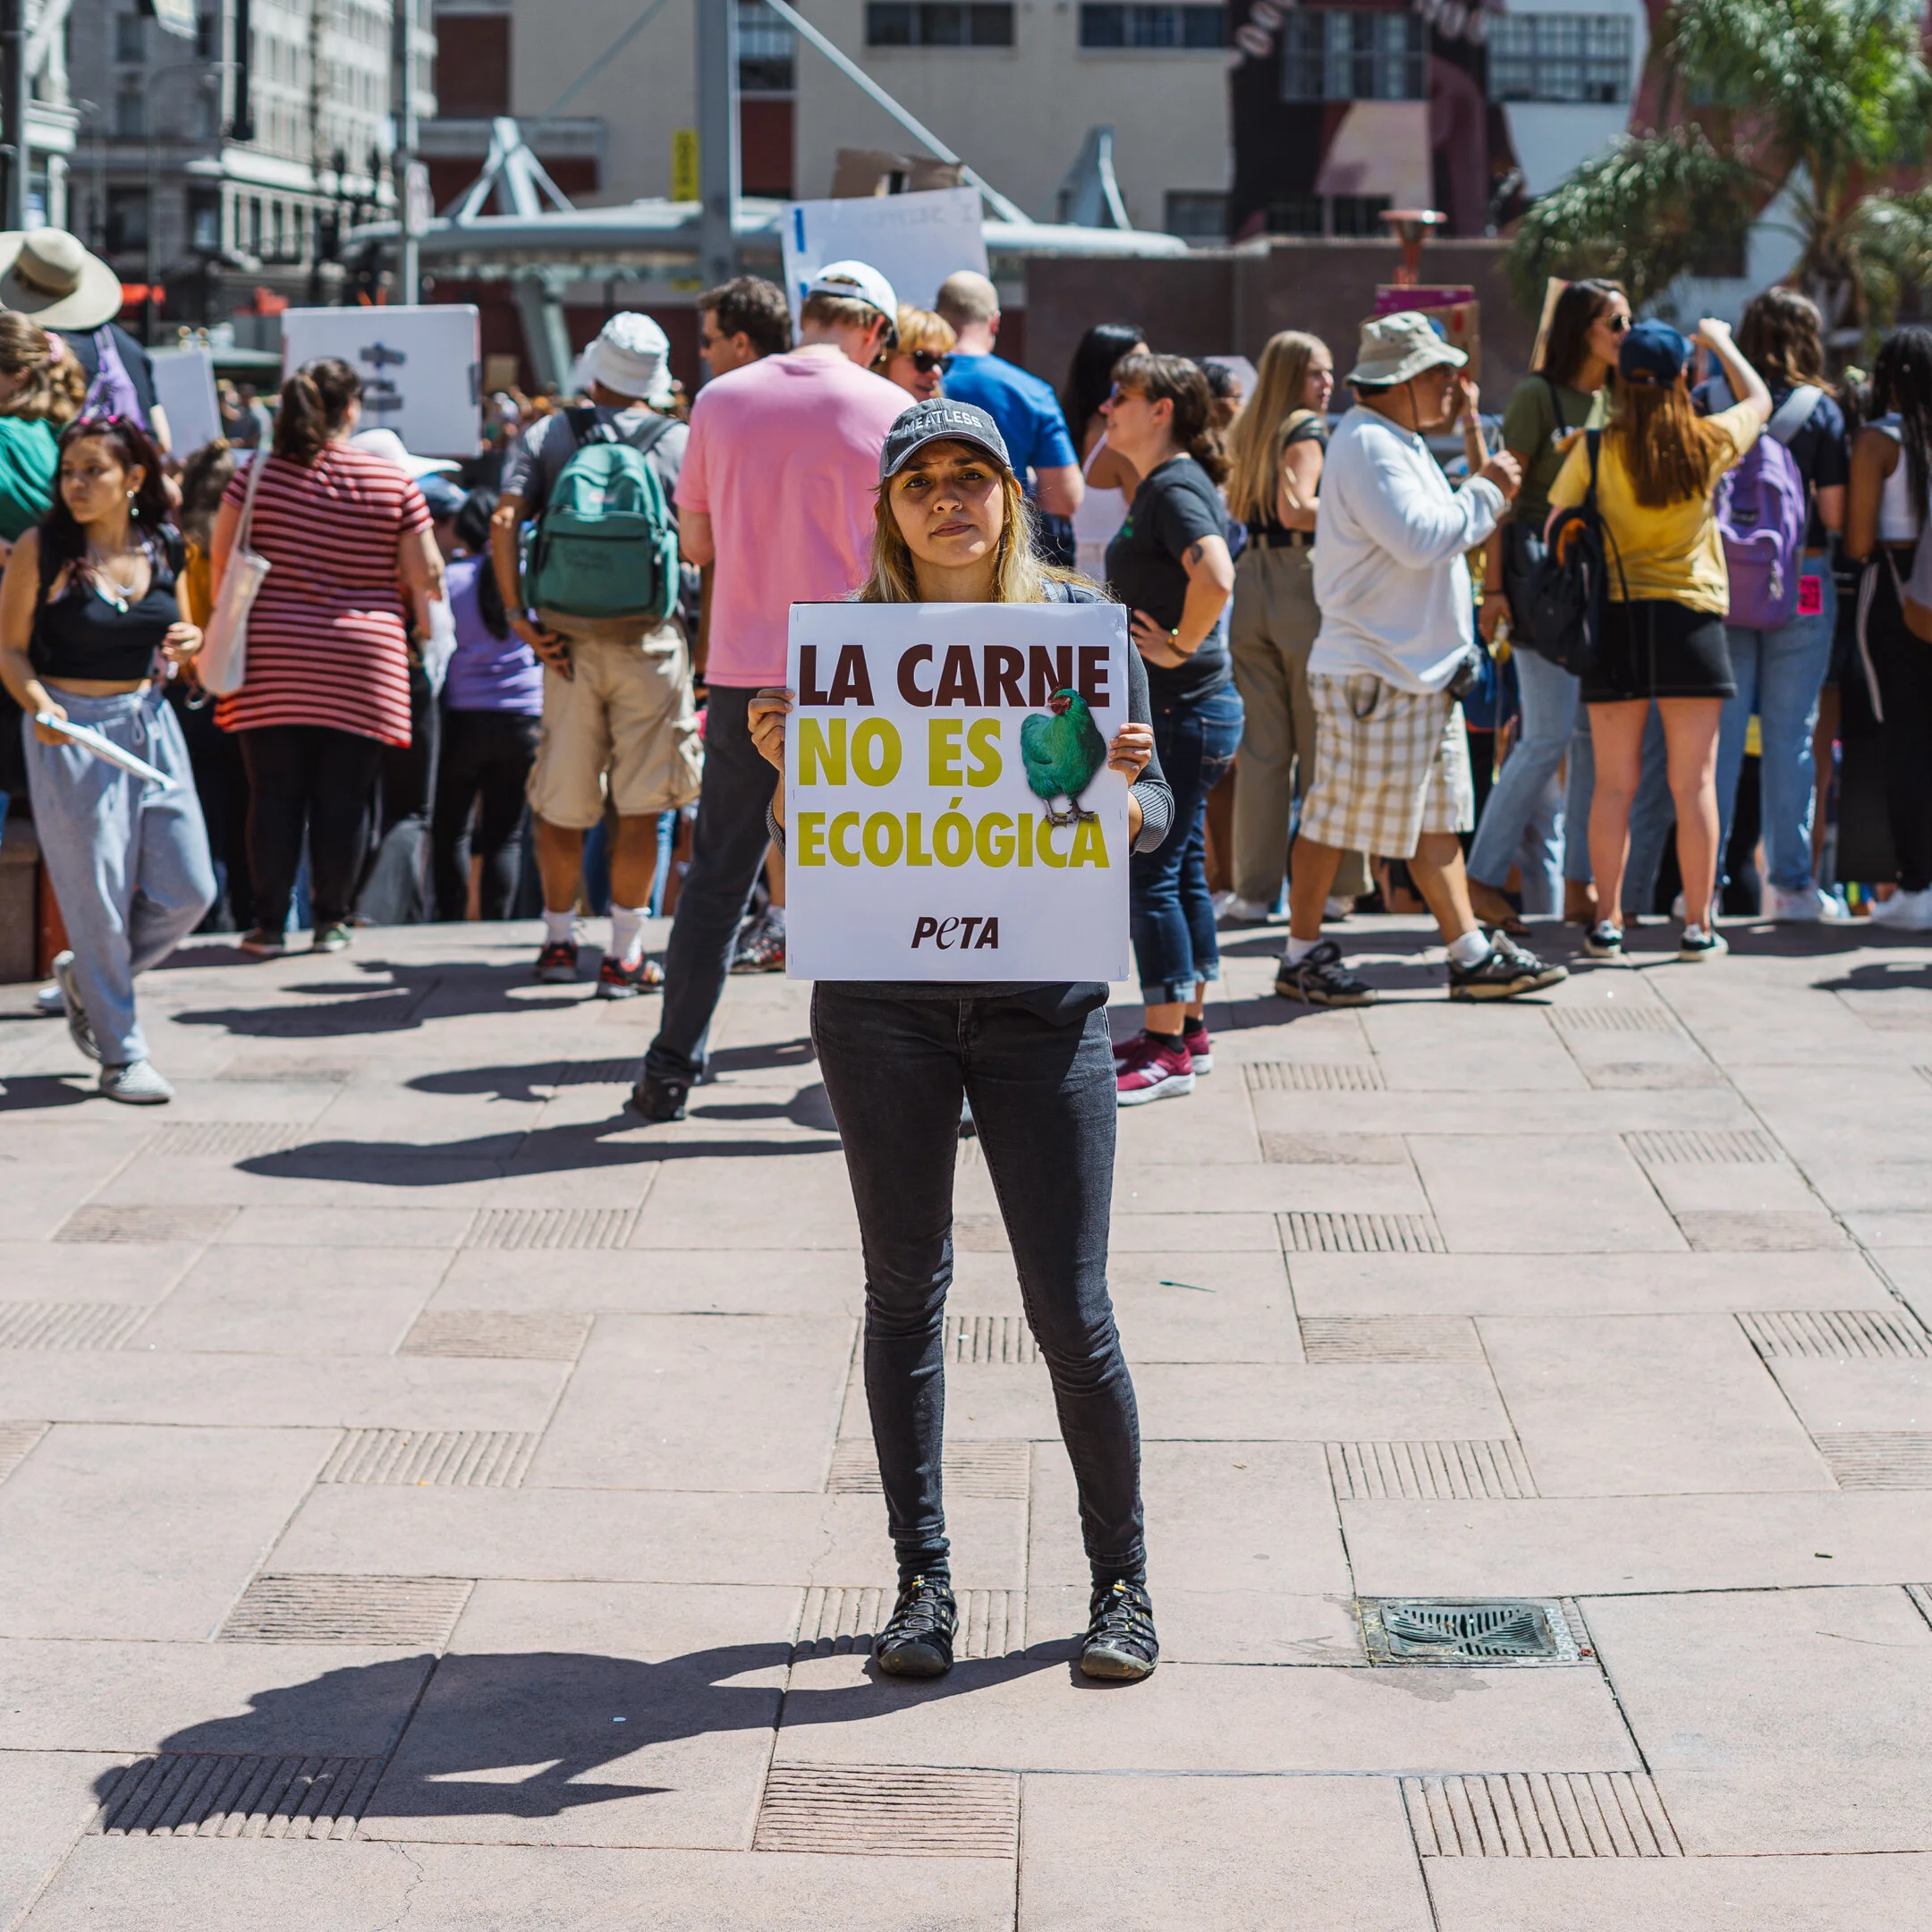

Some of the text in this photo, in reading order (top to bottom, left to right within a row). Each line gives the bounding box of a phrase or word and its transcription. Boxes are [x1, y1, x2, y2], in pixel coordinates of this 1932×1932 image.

[903, 410, 983, 435] MEATLESS
[799, 643, 1110, 708] LA CARNE
[798, 716, 1003, 788] NO ES
[797, 796, 1111, 869] ECOLÓGICA
